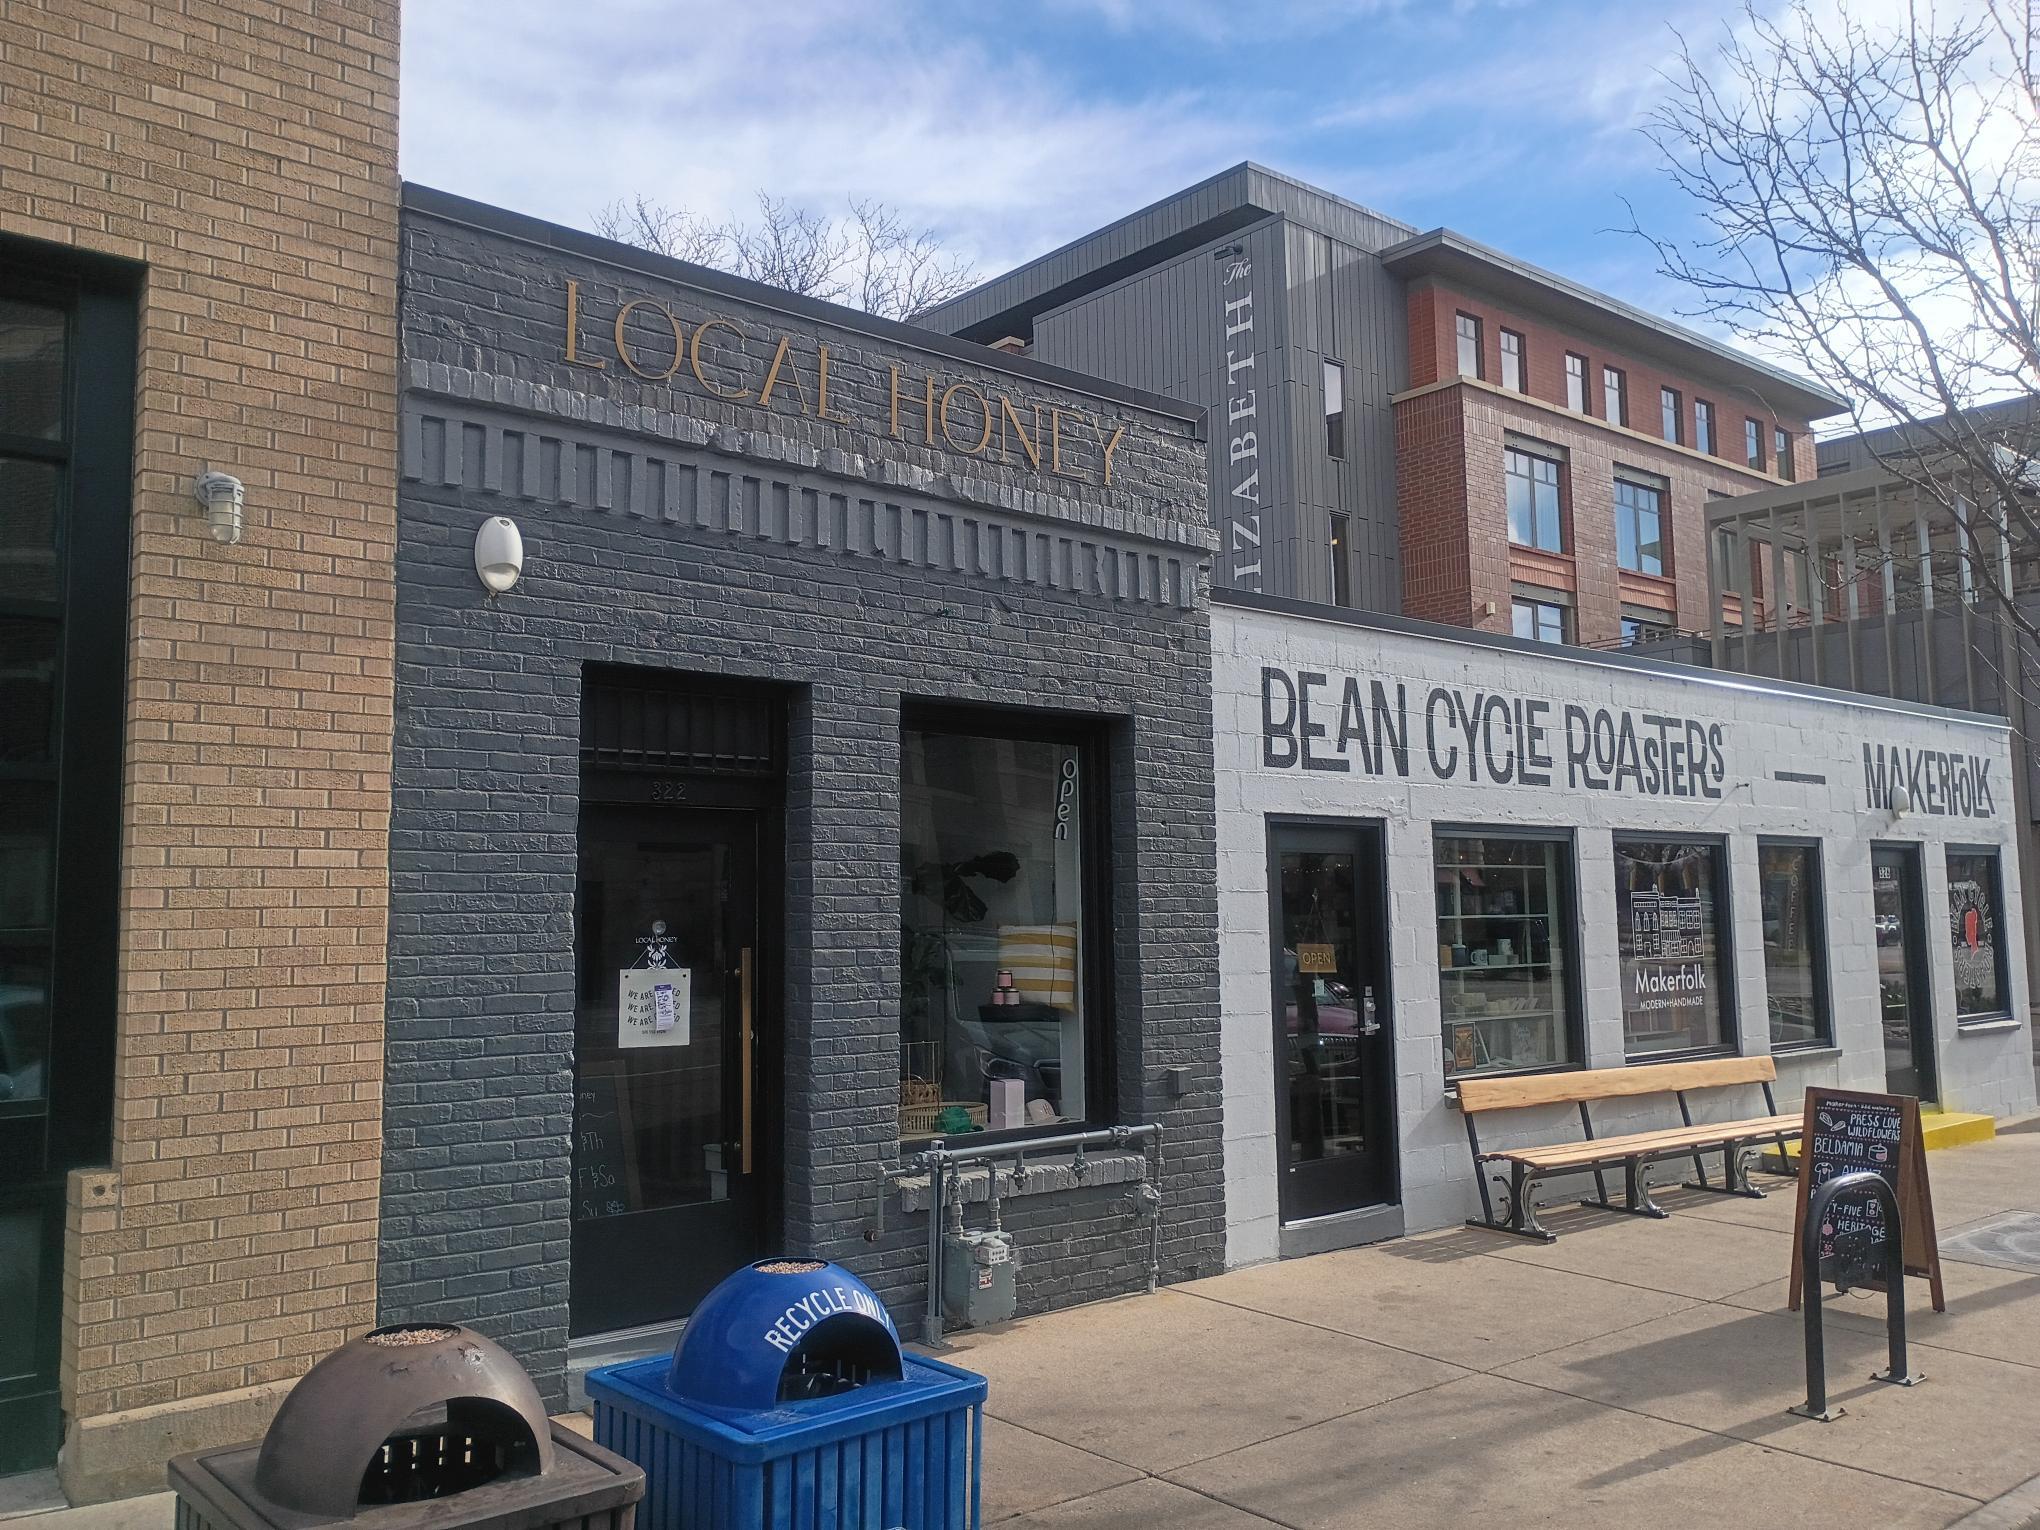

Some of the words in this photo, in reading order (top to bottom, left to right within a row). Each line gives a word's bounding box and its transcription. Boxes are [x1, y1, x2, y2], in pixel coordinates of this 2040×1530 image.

[1223, 257, 1252, 286] The
[564, 279, 850, 425] LOCAL
[888, 363, 1125, 487] HONEY
[1224, 291, 1262, 594] IZABETH
[1261, 666, 1410, 776] BEAN
[1425, 687, 1553, 786] CYCLE
[1567, 703, 1725, 799] ROASTERS
[649, 781, 687, 801] 322
[1862, 742, 1996, 819] MAKERFOLK
[1788, 856, 1800, 952] COFFEE
[1967, 879, 1994, 932] CYCLE
[635, 936, 655, 944] LOCAL
[1302, 951, 1332, 966] OPEN
[1635, 963, 1707, 995] Makerfolk
[627, 989, 639, 1000] WE
[639, 990, 654, 1001] ARE
[627, 1003, 639, 1013] WE
[639, 1003, 654, 1014] ARE
[627, 1015, 639, 1026] WE
[639, 1015, 654, 1026] ARE
[1847, 1125, 1901, 1141] WILDFLOWERS
[1850, 1113, 1880, 1128] PRESS
[1882, 1116, 1901, 1129] LOVE
[1814, 1137, 1864, 1157] BELDAMIA
[763, 1287, 853, 1353] RECYCLE
[852, 1289, 892, 1329] ONLY
